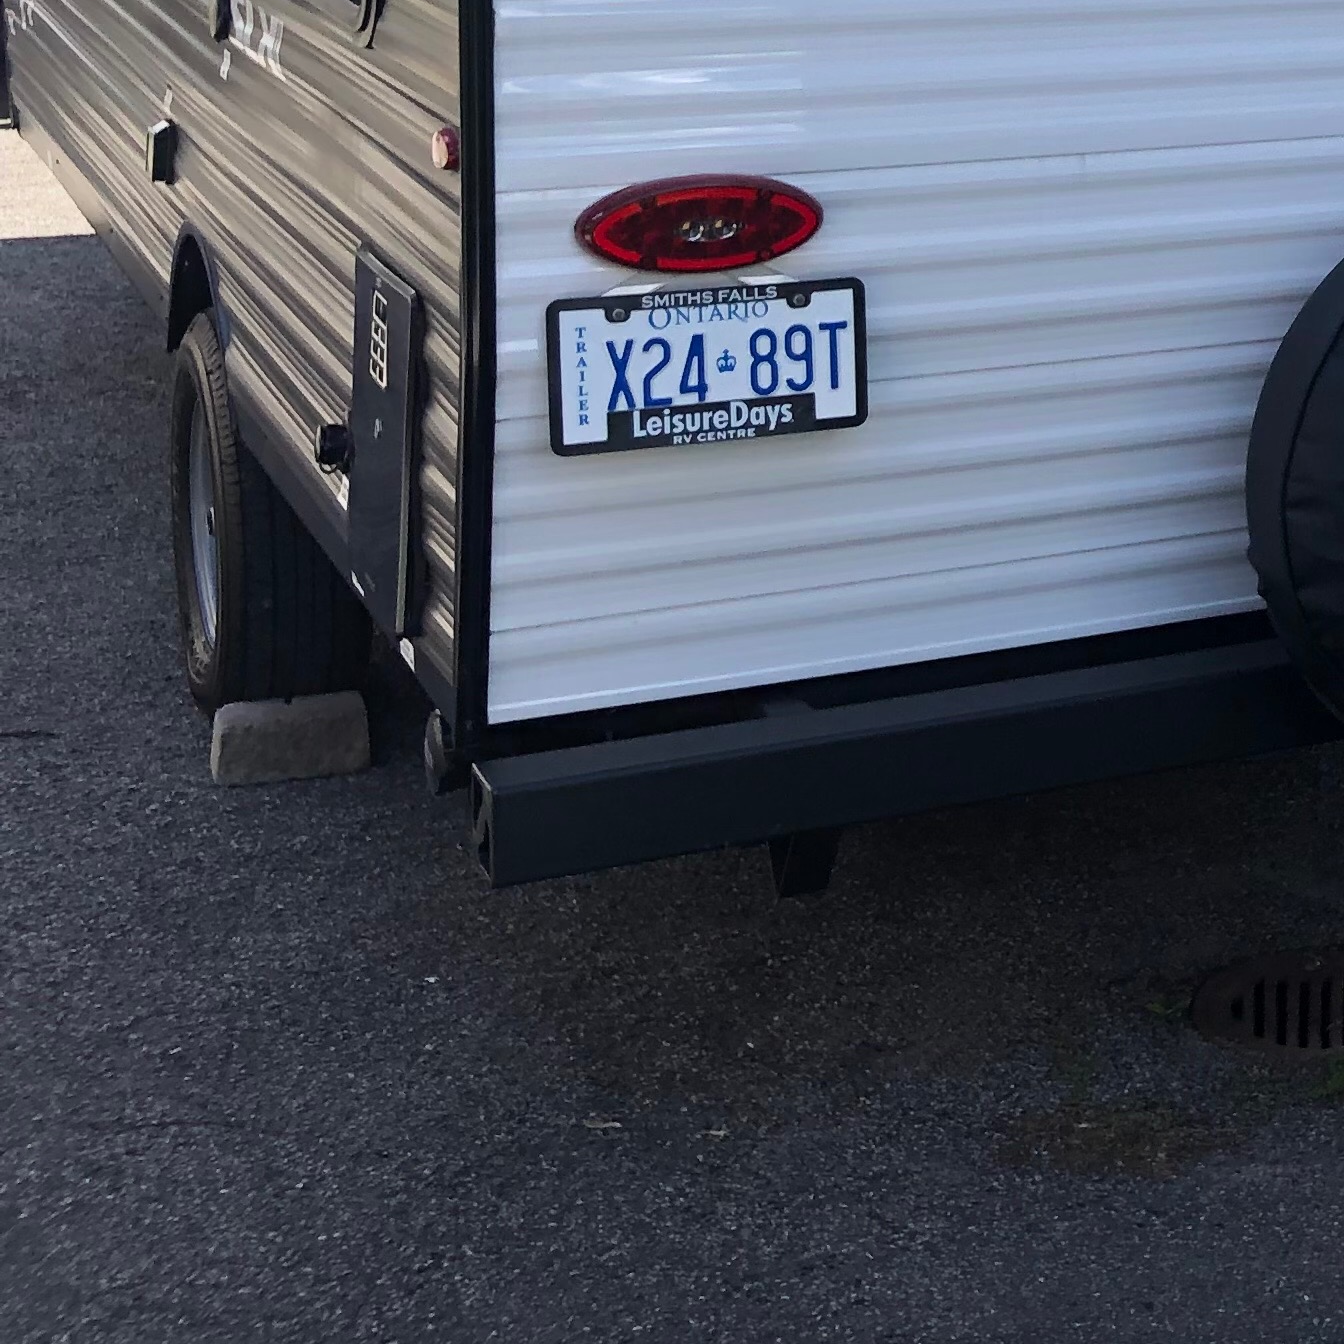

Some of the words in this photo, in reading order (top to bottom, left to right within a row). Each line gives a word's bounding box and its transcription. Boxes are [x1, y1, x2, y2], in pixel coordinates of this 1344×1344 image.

[641, 290, 714, 309] SMITHS
[718, 285, 778, 304] FALLS
[648, 300, 769, 330] ONTARIO
[575, 326, 590, 427] TRAILER
[605, 333, 709, 413] X24
[749, 320, 848, 396] 89T
[632, 400, 795, 439] LeisureDays
[673, 433, 694, 445] RV
[696, 428, 757, 443] CENTRE
